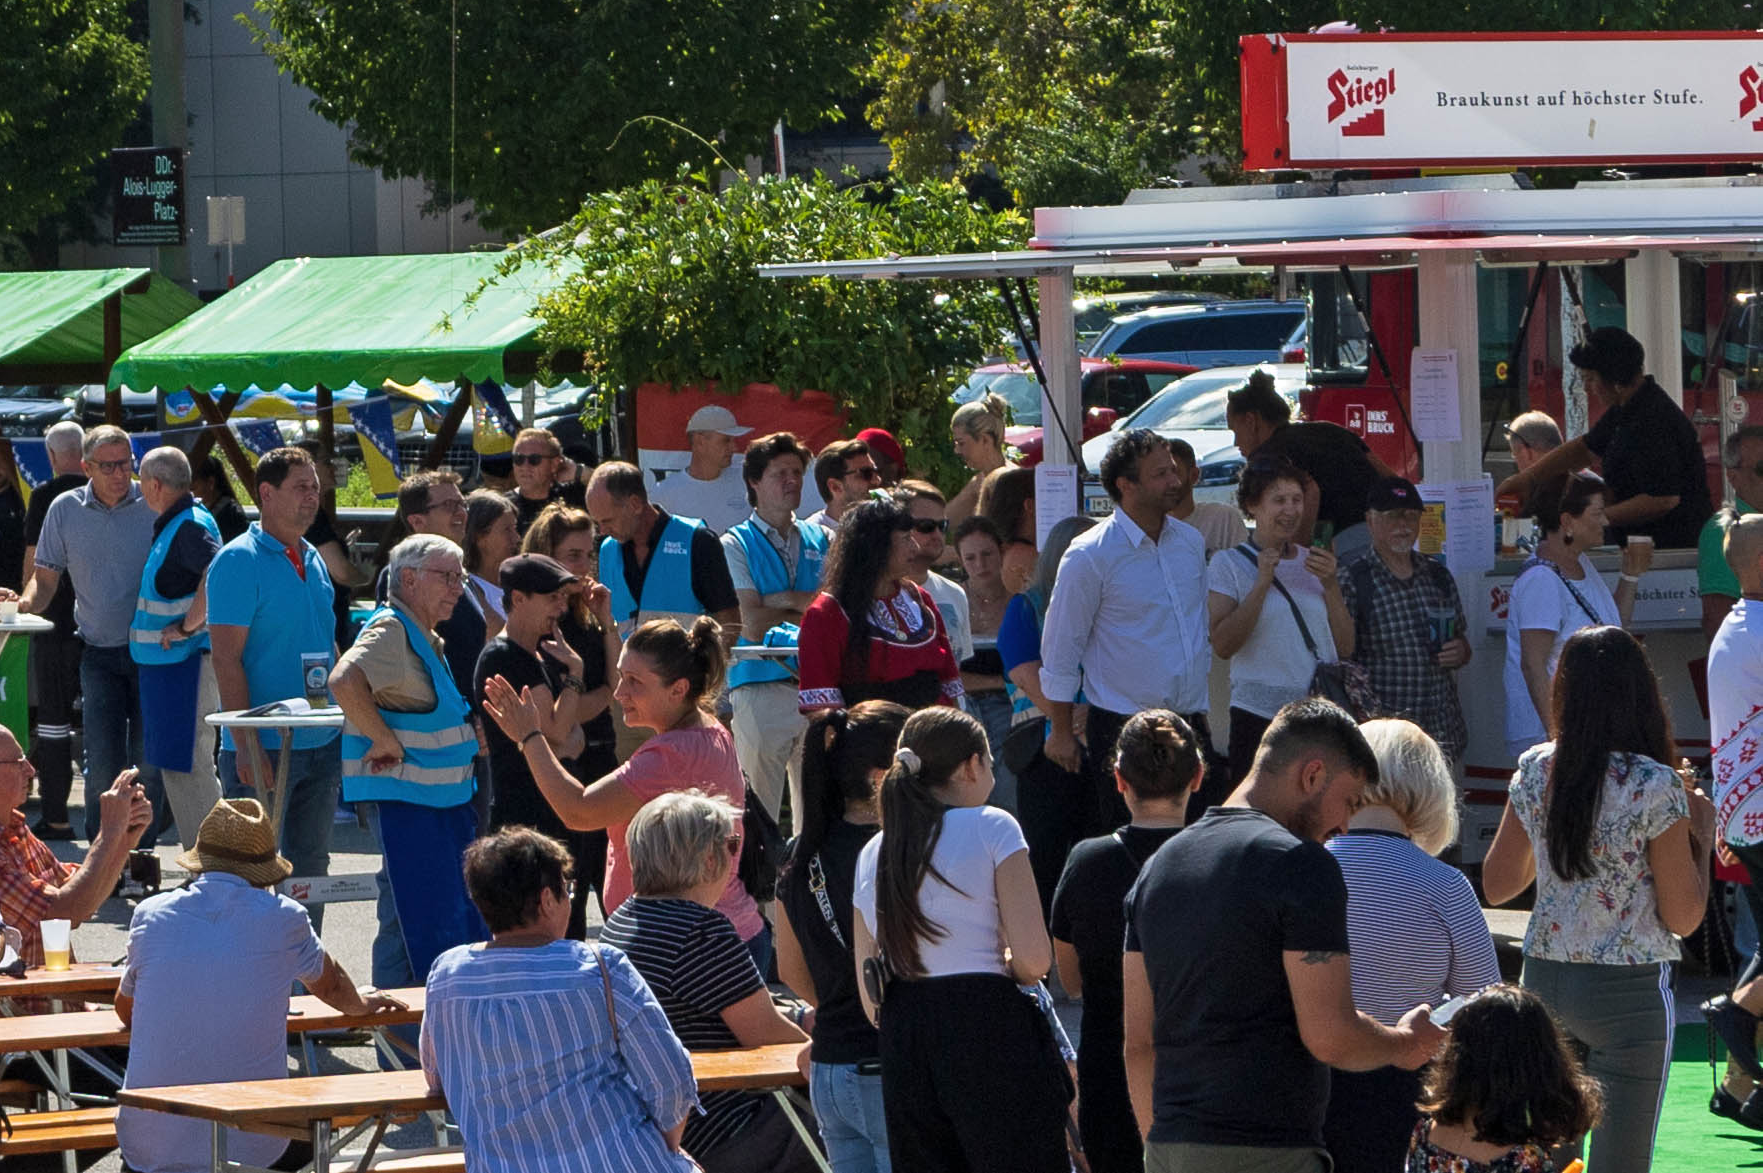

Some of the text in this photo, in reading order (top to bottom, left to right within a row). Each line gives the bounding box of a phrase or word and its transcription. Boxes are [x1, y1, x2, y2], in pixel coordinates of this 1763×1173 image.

[1327, 67, 1396, 124] Stiegl
[1436, 87, 1705, 107] Braukunst auf höchster Stufe.
[122, 176, 178, 199] Alois-Lugger-
